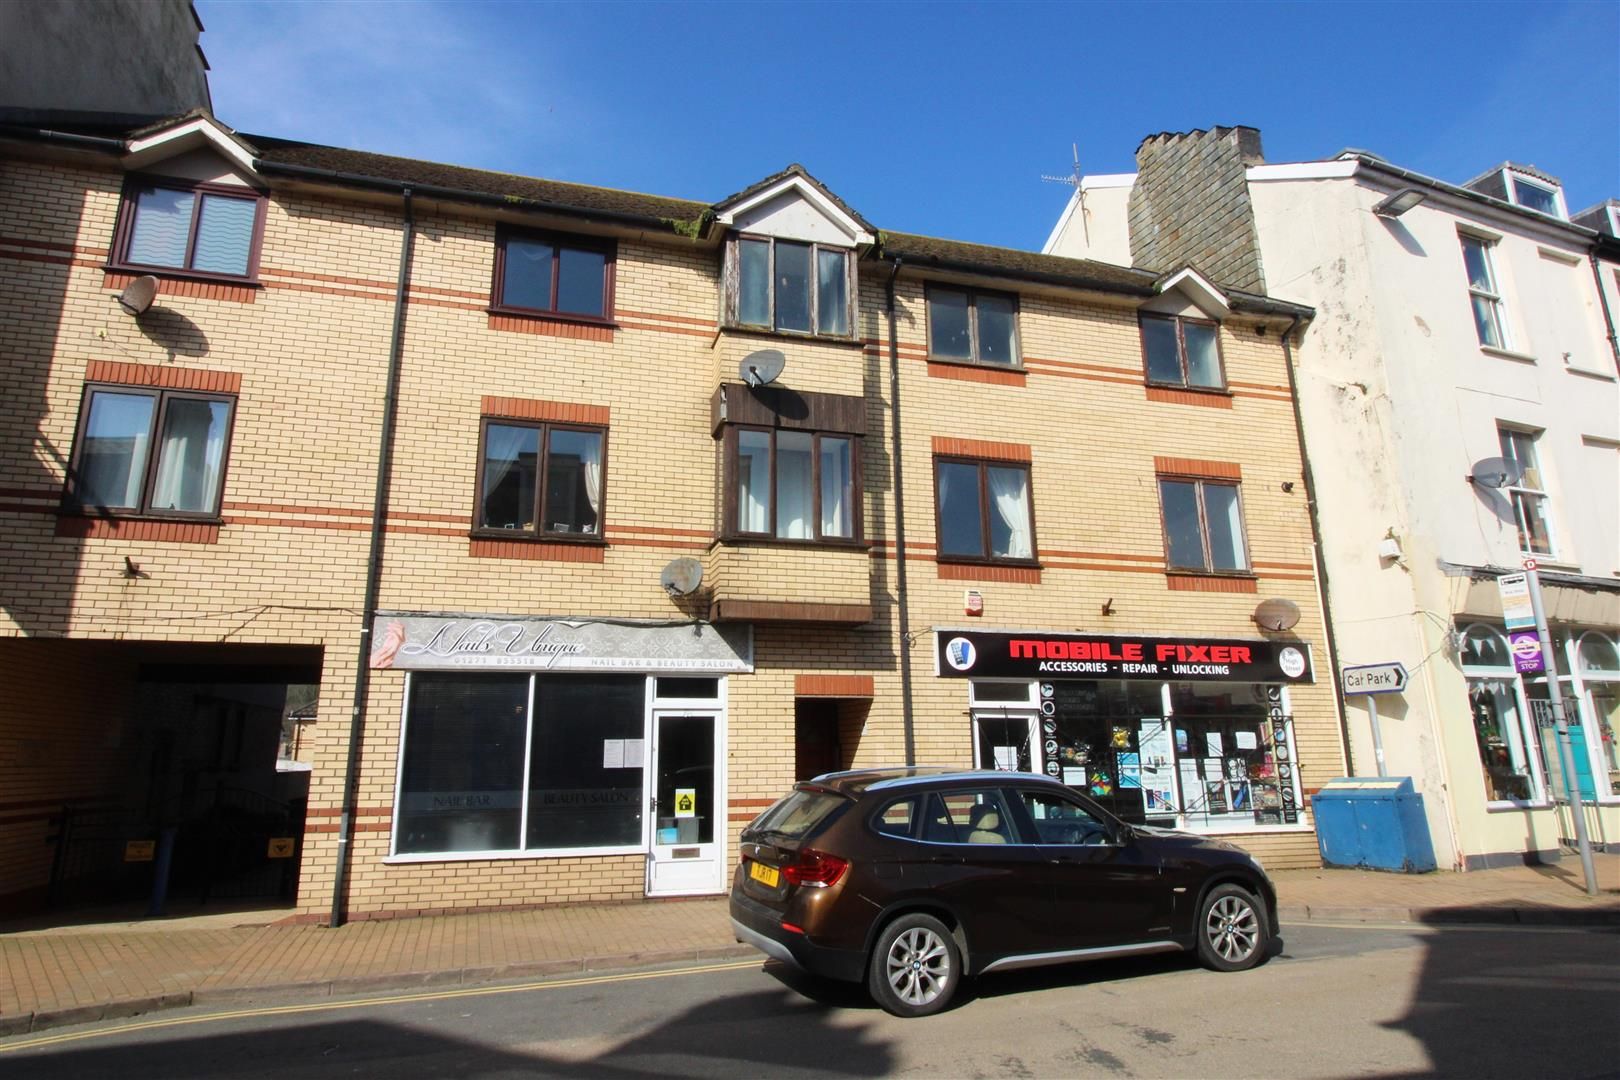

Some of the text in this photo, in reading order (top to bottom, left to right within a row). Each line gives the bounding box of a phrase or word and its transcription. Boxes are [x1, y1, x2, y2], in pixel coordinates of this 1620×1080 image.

[496, 623, 586, 669] Unique
[1009, 639, 1252, 664] MOBILE FIXER
[591, 658, 616, 666] NAIL
[657, 659, 697, 667] BEAUTY
[701, 659, 734, 668] SALON
[1039, 661, 1108, 673] ACCESSORIES
[1122, 663, 1158, 674] REPAIR
[1172, 664, 1230, 675] UNLOCKING
[1520, 662, 1538, 670] STOP
[1347, 672, 1391, 687] Car Park
[433, 794, 491, 807] NAIL BAR
[543, 791, 628, 804] BEAUTY SALON
